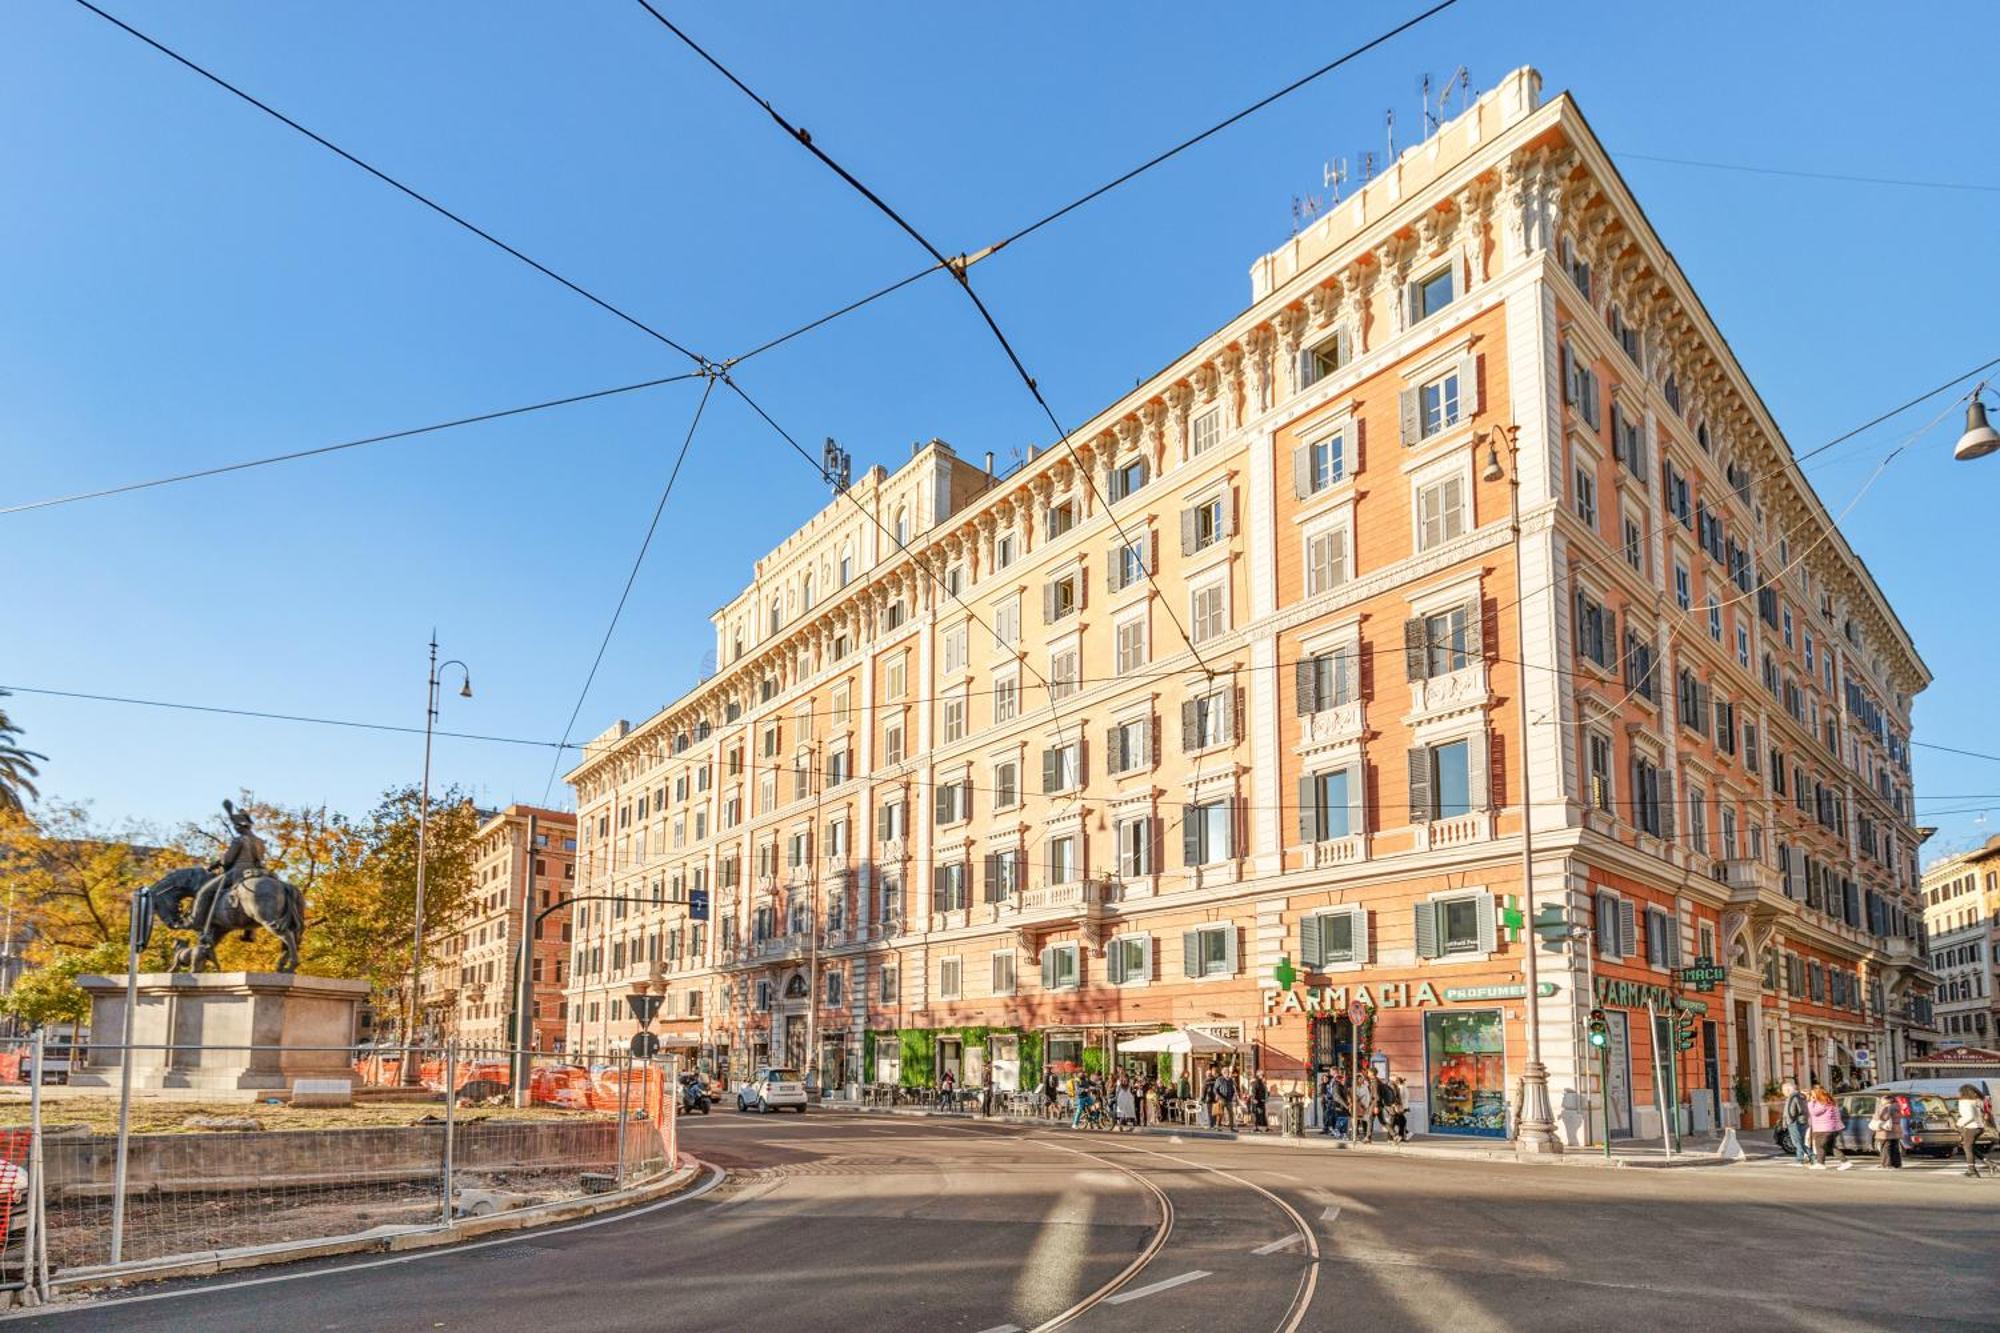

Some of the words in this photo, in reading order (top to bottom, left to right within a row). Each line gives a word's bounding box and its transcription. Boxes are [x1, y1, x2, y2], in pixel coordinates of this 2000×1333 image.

[1263, 981, 1438, 1013] FARMACIA
[1447, 984, 1547, 998] PROFUMERA
[1596, 976, 1672, 1012] FARMACIA
